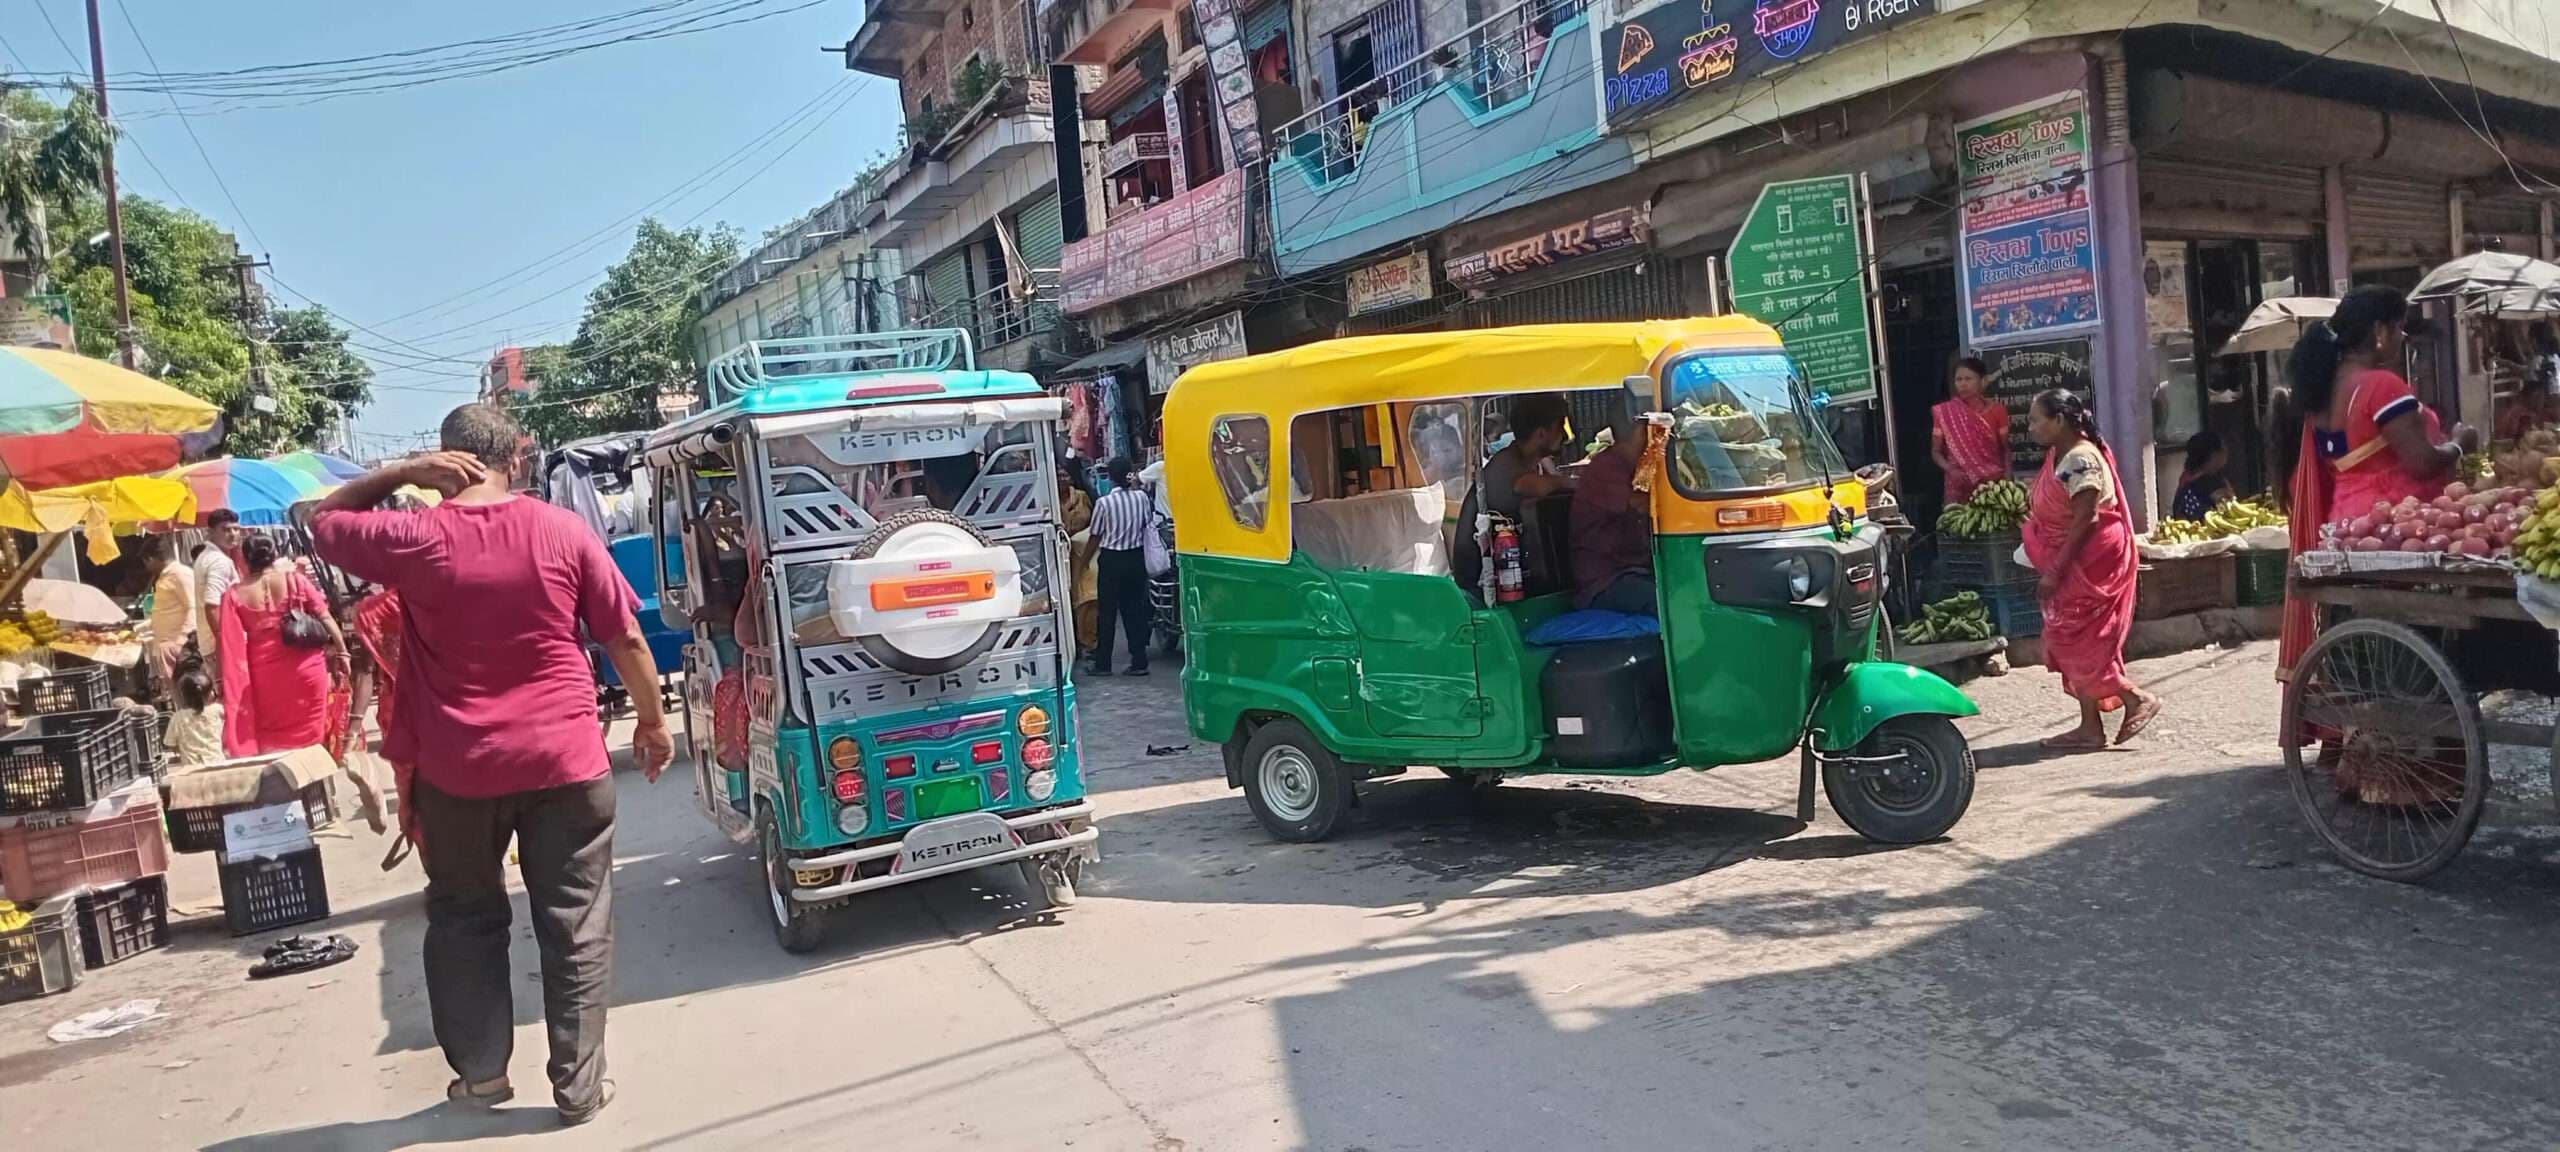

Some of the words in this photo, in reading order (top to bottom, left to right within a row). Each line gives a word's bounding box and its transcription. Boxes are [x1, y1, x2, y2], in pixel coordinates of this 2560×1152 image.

[1773, 24, 1807, 49] SHOP
[1606, 67, 1668, 113] Pizza
[2029, 117, 2075, 145] Toys
[2037, 227, 2088, 255] Toys
[1762, 264, 1785, 287] वार्ड
[1822, 264, 1831, 279] 5
[1761, 296, 1774, 314] श्री
[1780, 297, 1798, 311] राम
[1817, 308, 1840, 325] मार्ग
[1170, 334, 1188, 358] शिव
[1189, 322, 1220, 352] ज्वेलर्स
[840, 427, 967, 450] KETRON
[828, 661, 1037, 709] KETRON
[912, 833, 1001, 862] KETRON
